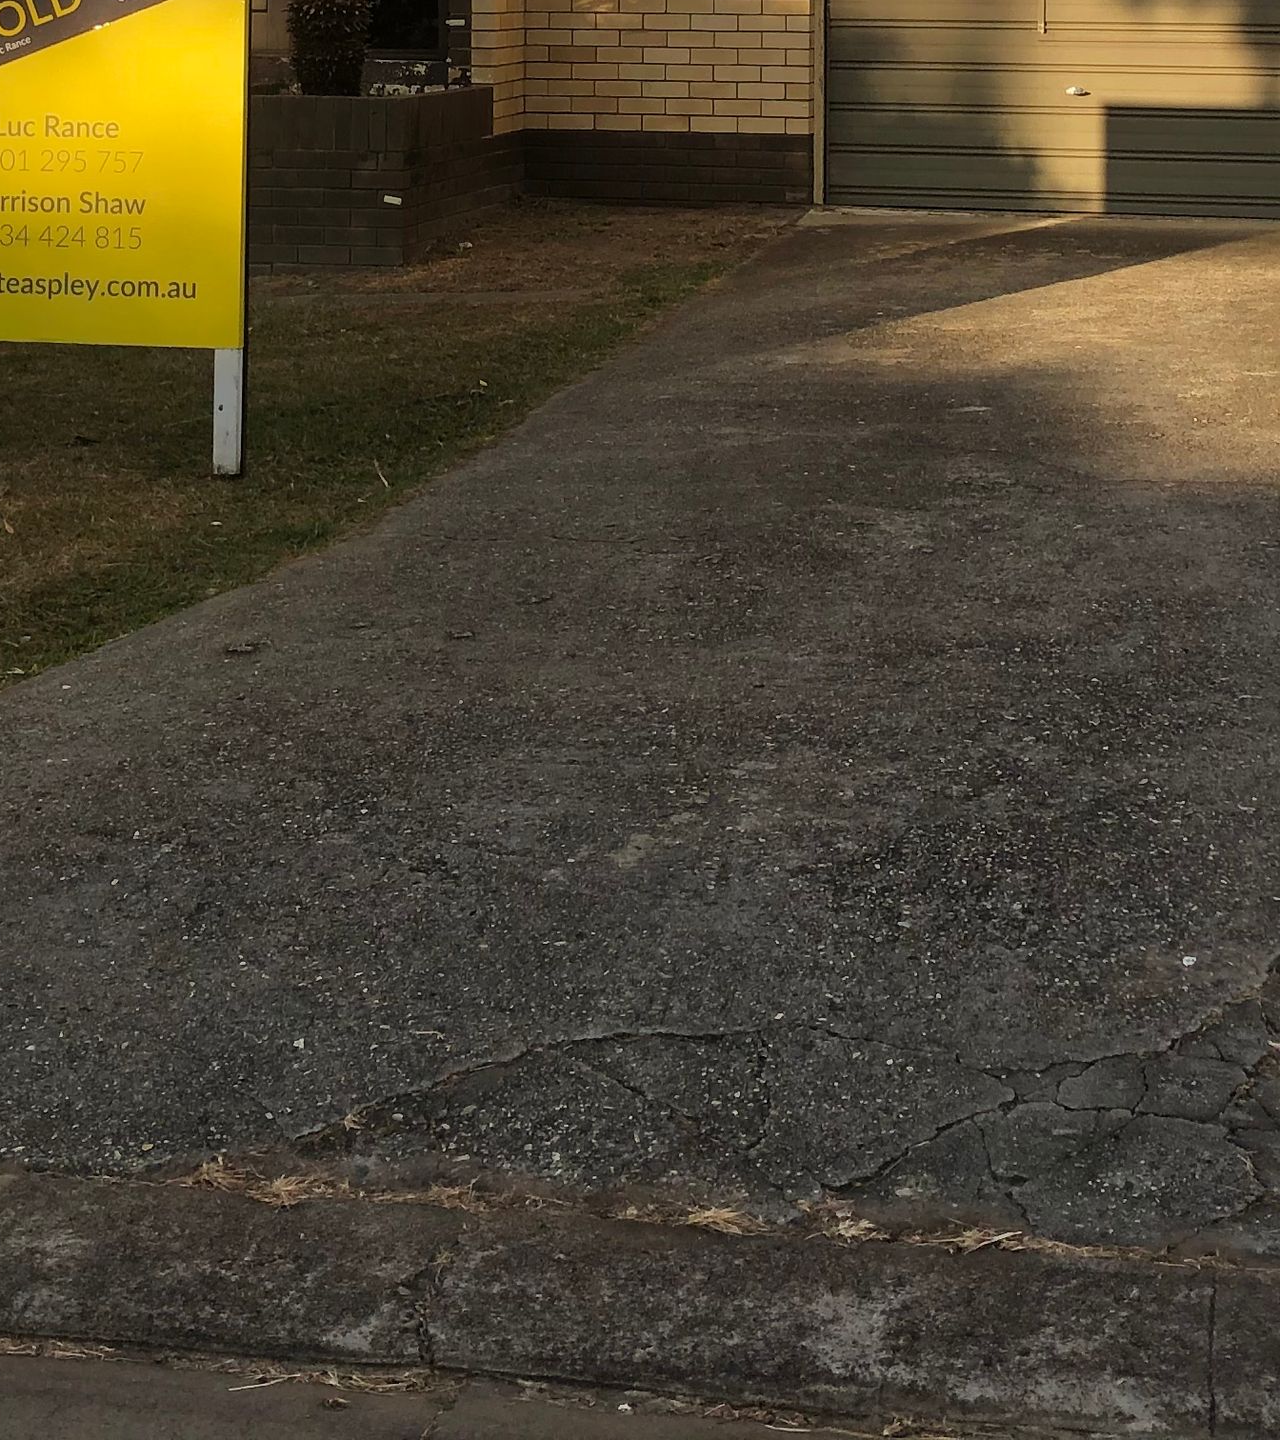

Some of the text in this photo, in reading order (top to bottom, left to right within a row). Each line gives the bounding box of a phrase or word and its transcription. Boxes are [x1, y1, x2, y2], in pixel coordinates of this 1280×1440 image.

[4, 36, 32, 52] Rance
[44, 114, 120, 139] Rance
[40, 148, 87, 173] 295
[97, 150, 145, 174] 757
[78, 191, 147, 216] Shaw
[38, 224, 87, 249] 424
[94, 225, 143, 250] 815
